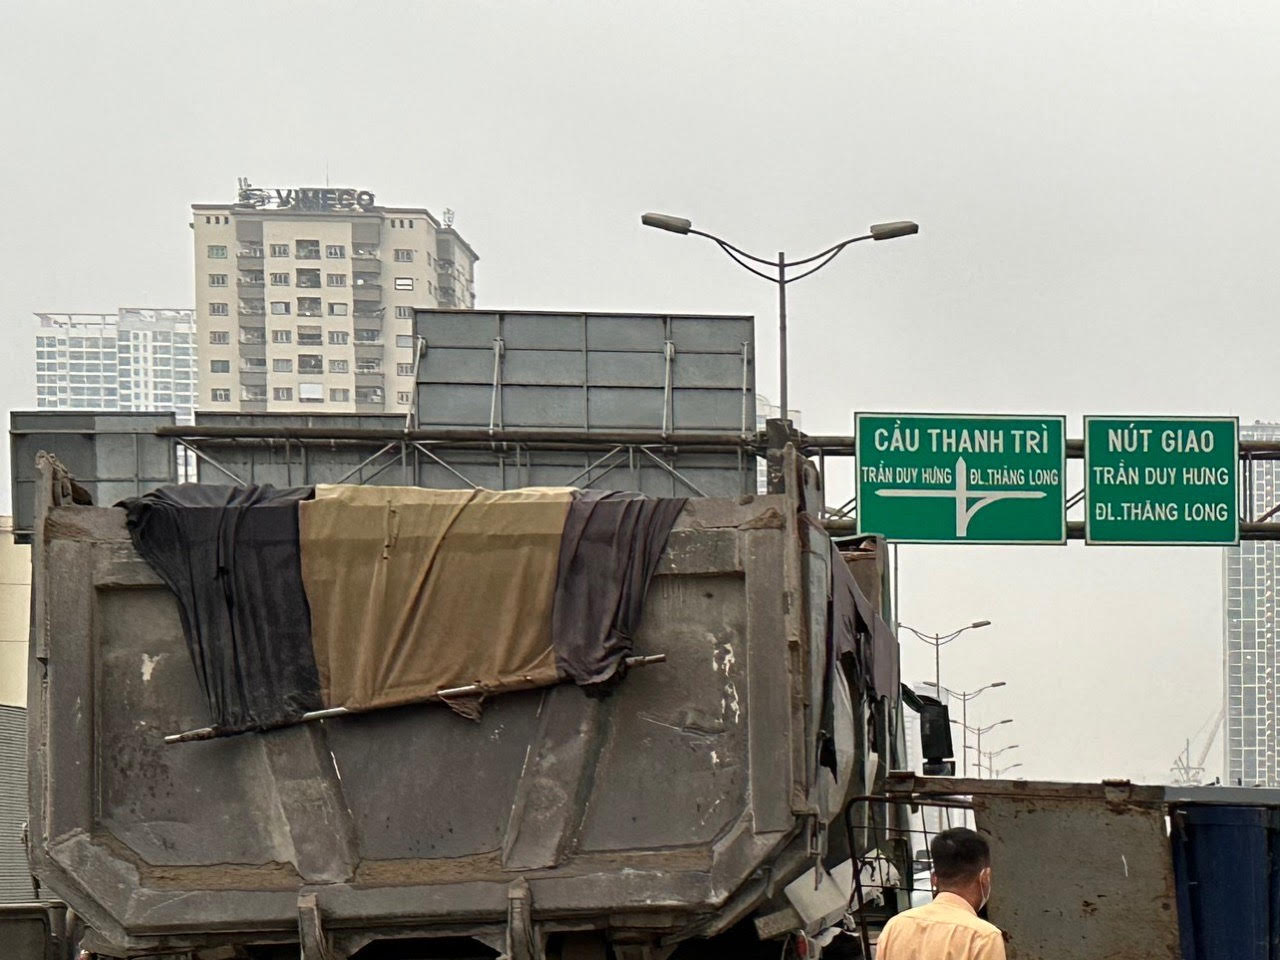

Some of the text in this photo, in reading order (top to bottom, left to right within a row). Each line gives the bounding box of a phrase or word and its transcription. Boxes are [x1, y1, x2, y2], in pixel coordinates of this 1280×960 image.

[874, 419, 1049, 454] CẦU THANH TRÌ
[1107, 423, 1214, 453] NÚT GIAO
[861, 460, 952, 485] TRẦN DUY HƯNG
[1029, 468, 1059, 486] LONG
[1093, 459, 1229, 486] TRẦN DUY HƯNG
[1184, 503, 1228, 522] LONG
